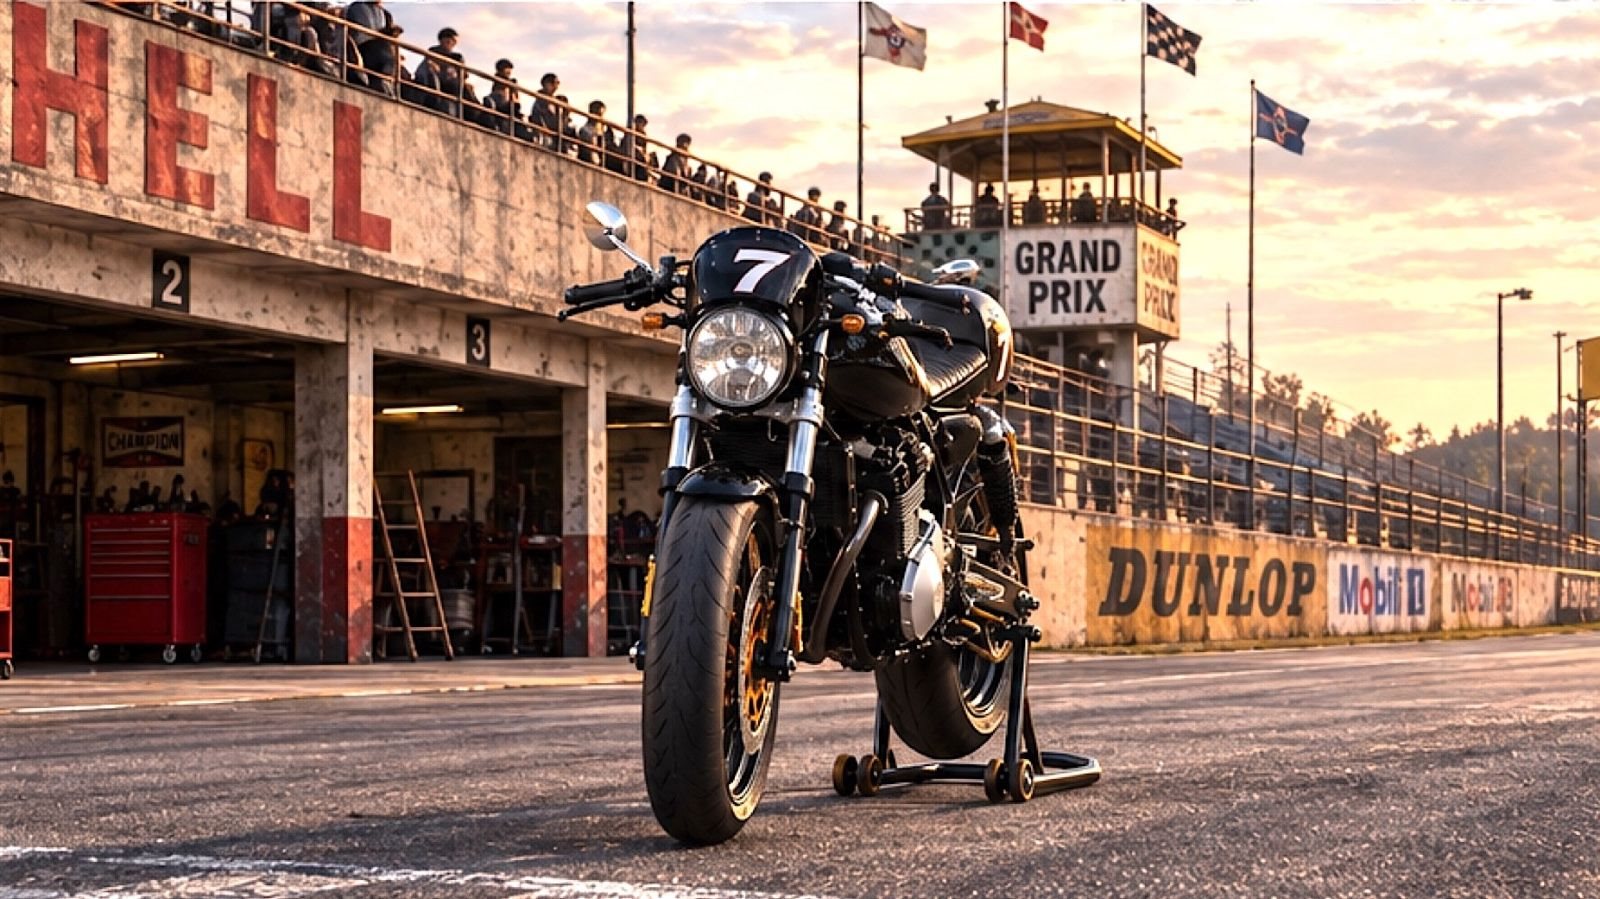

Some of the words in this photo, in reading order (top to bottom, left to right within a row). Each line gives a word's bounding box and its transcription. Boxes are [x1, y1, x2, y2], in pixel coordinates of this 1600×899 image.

[12, 1, 391, 252] HELL
[733, 249, 791, 294] 7
[1015, 239, 1121, 275] GRAND
[161, 260, 183, 304] 2
[1029, 279, 1107, 314] PRIX
[471, 324, 485, 361] 3
[108, 431, 179, 451] CHAMPION
[1098, 547, 1315, 617] DUNLOP
